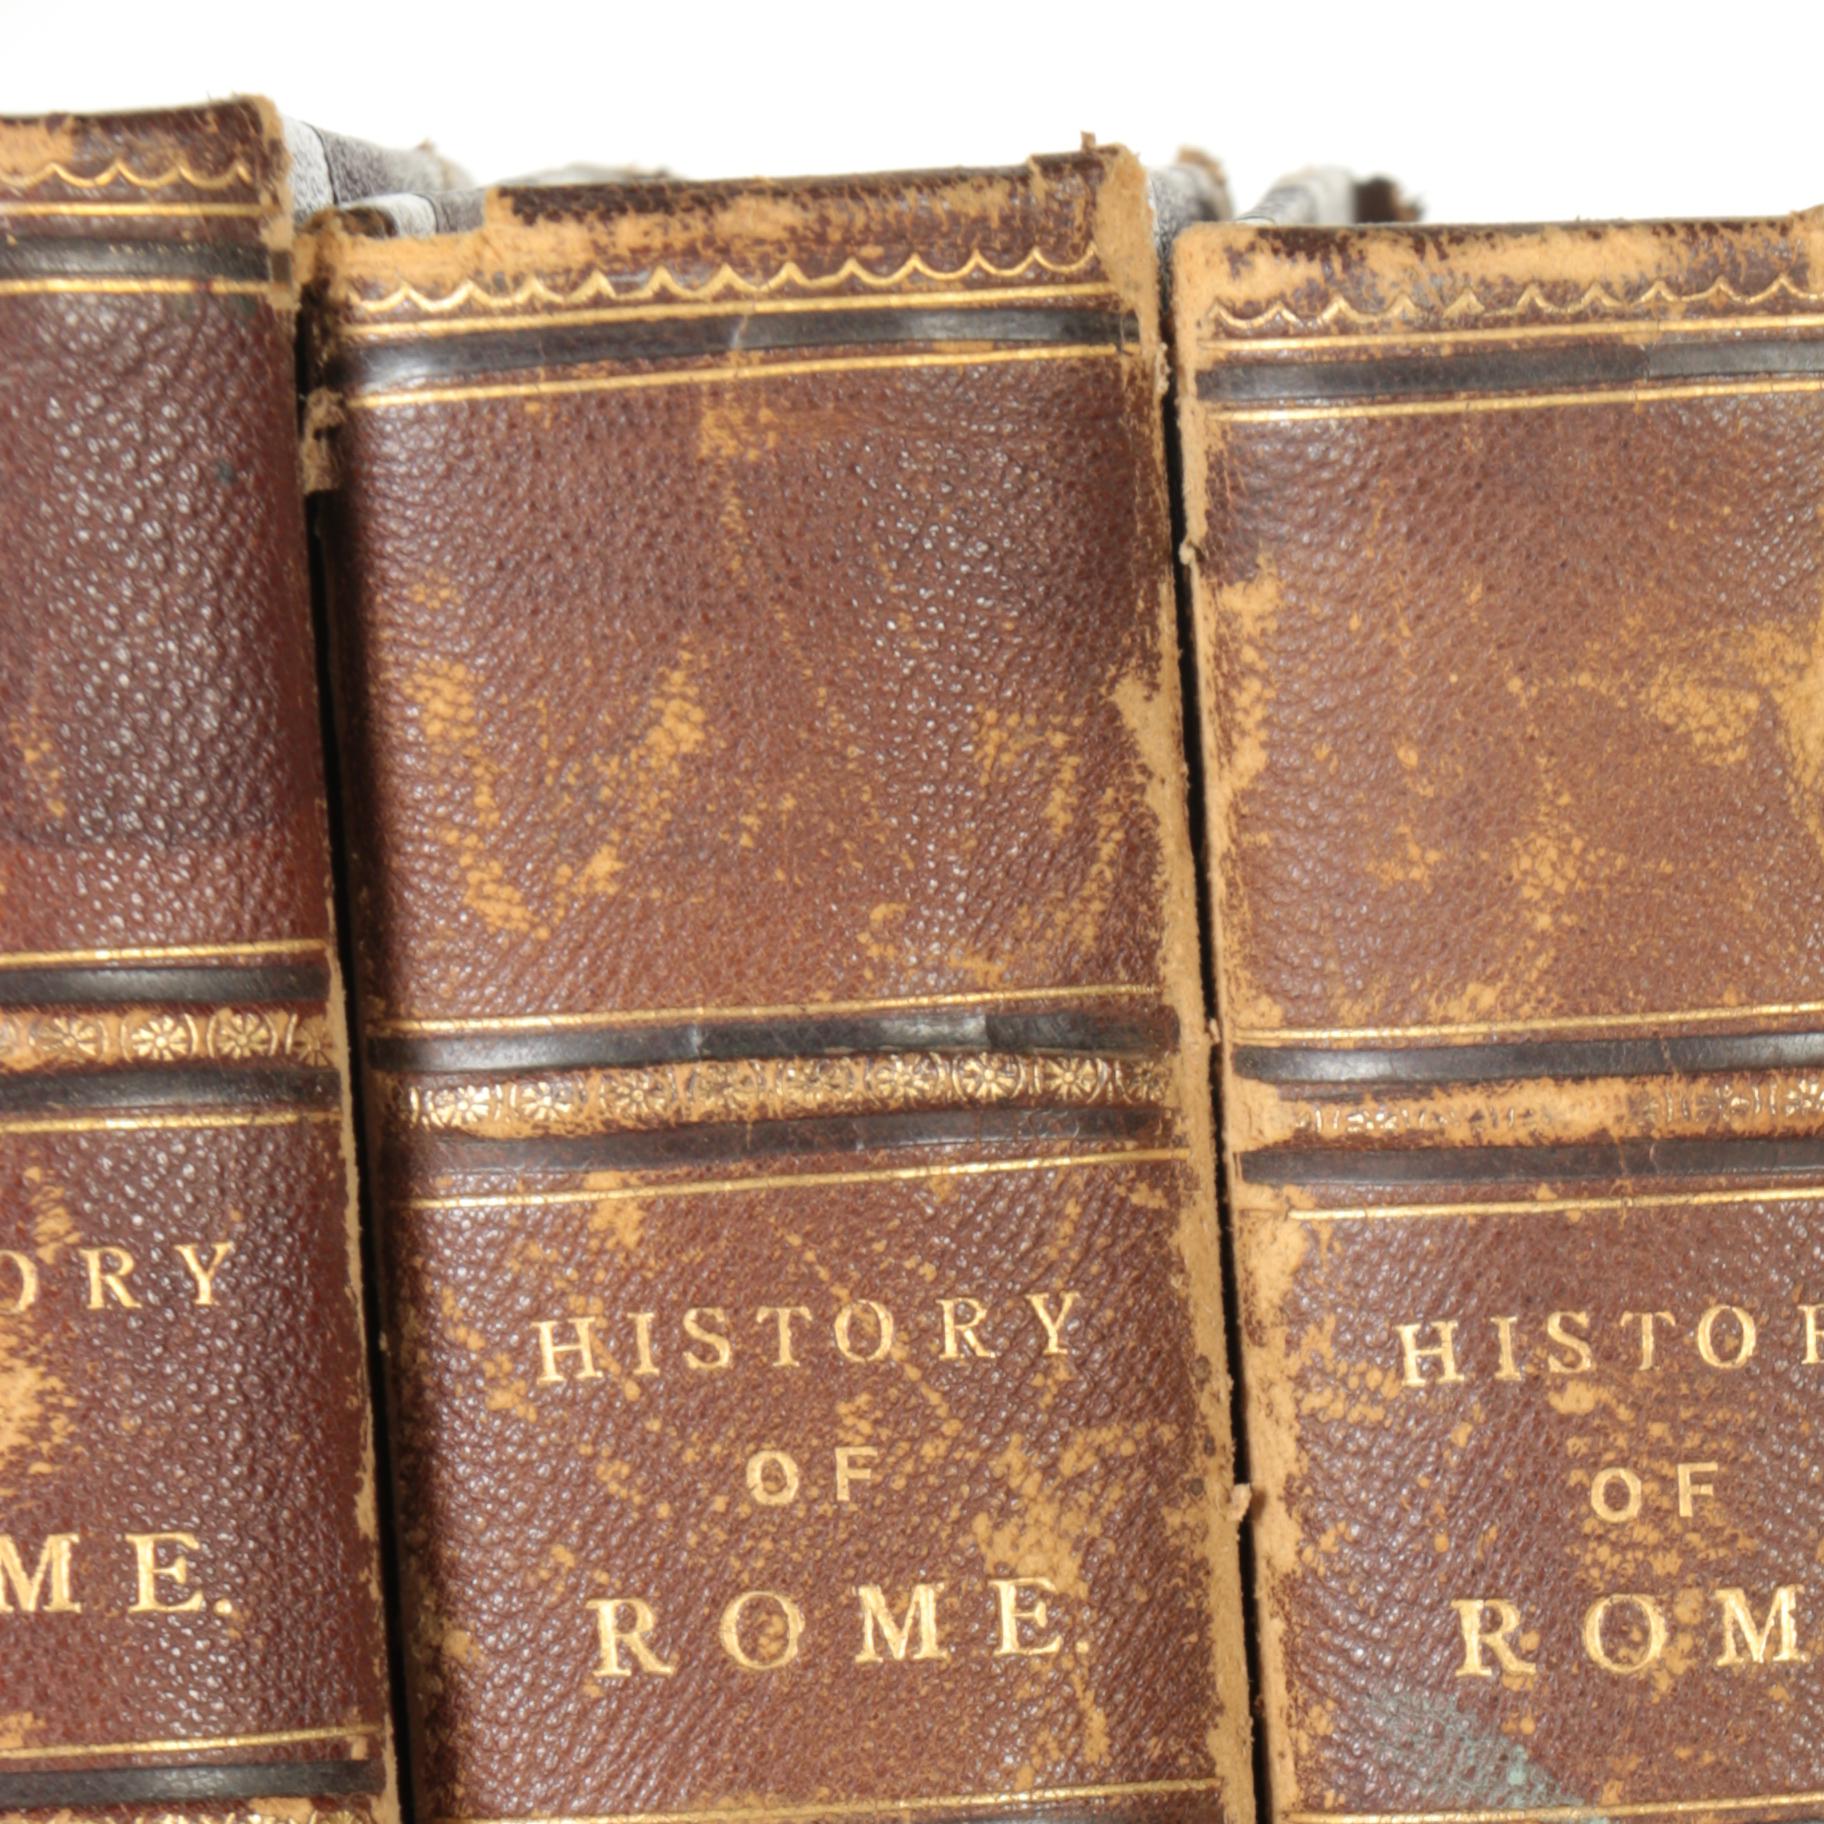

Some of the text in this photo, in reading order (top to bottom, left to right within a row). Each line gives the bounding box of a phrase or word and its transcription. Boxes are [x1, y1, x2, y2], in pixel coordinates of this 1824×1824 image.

[530, 1290, 1081, 1385] HISTORY
[745, 1446, 878, 1505] OF
[1590, 1462, 1718, 1522] OF
[586, 1576, 1089, 1678] ROME.
